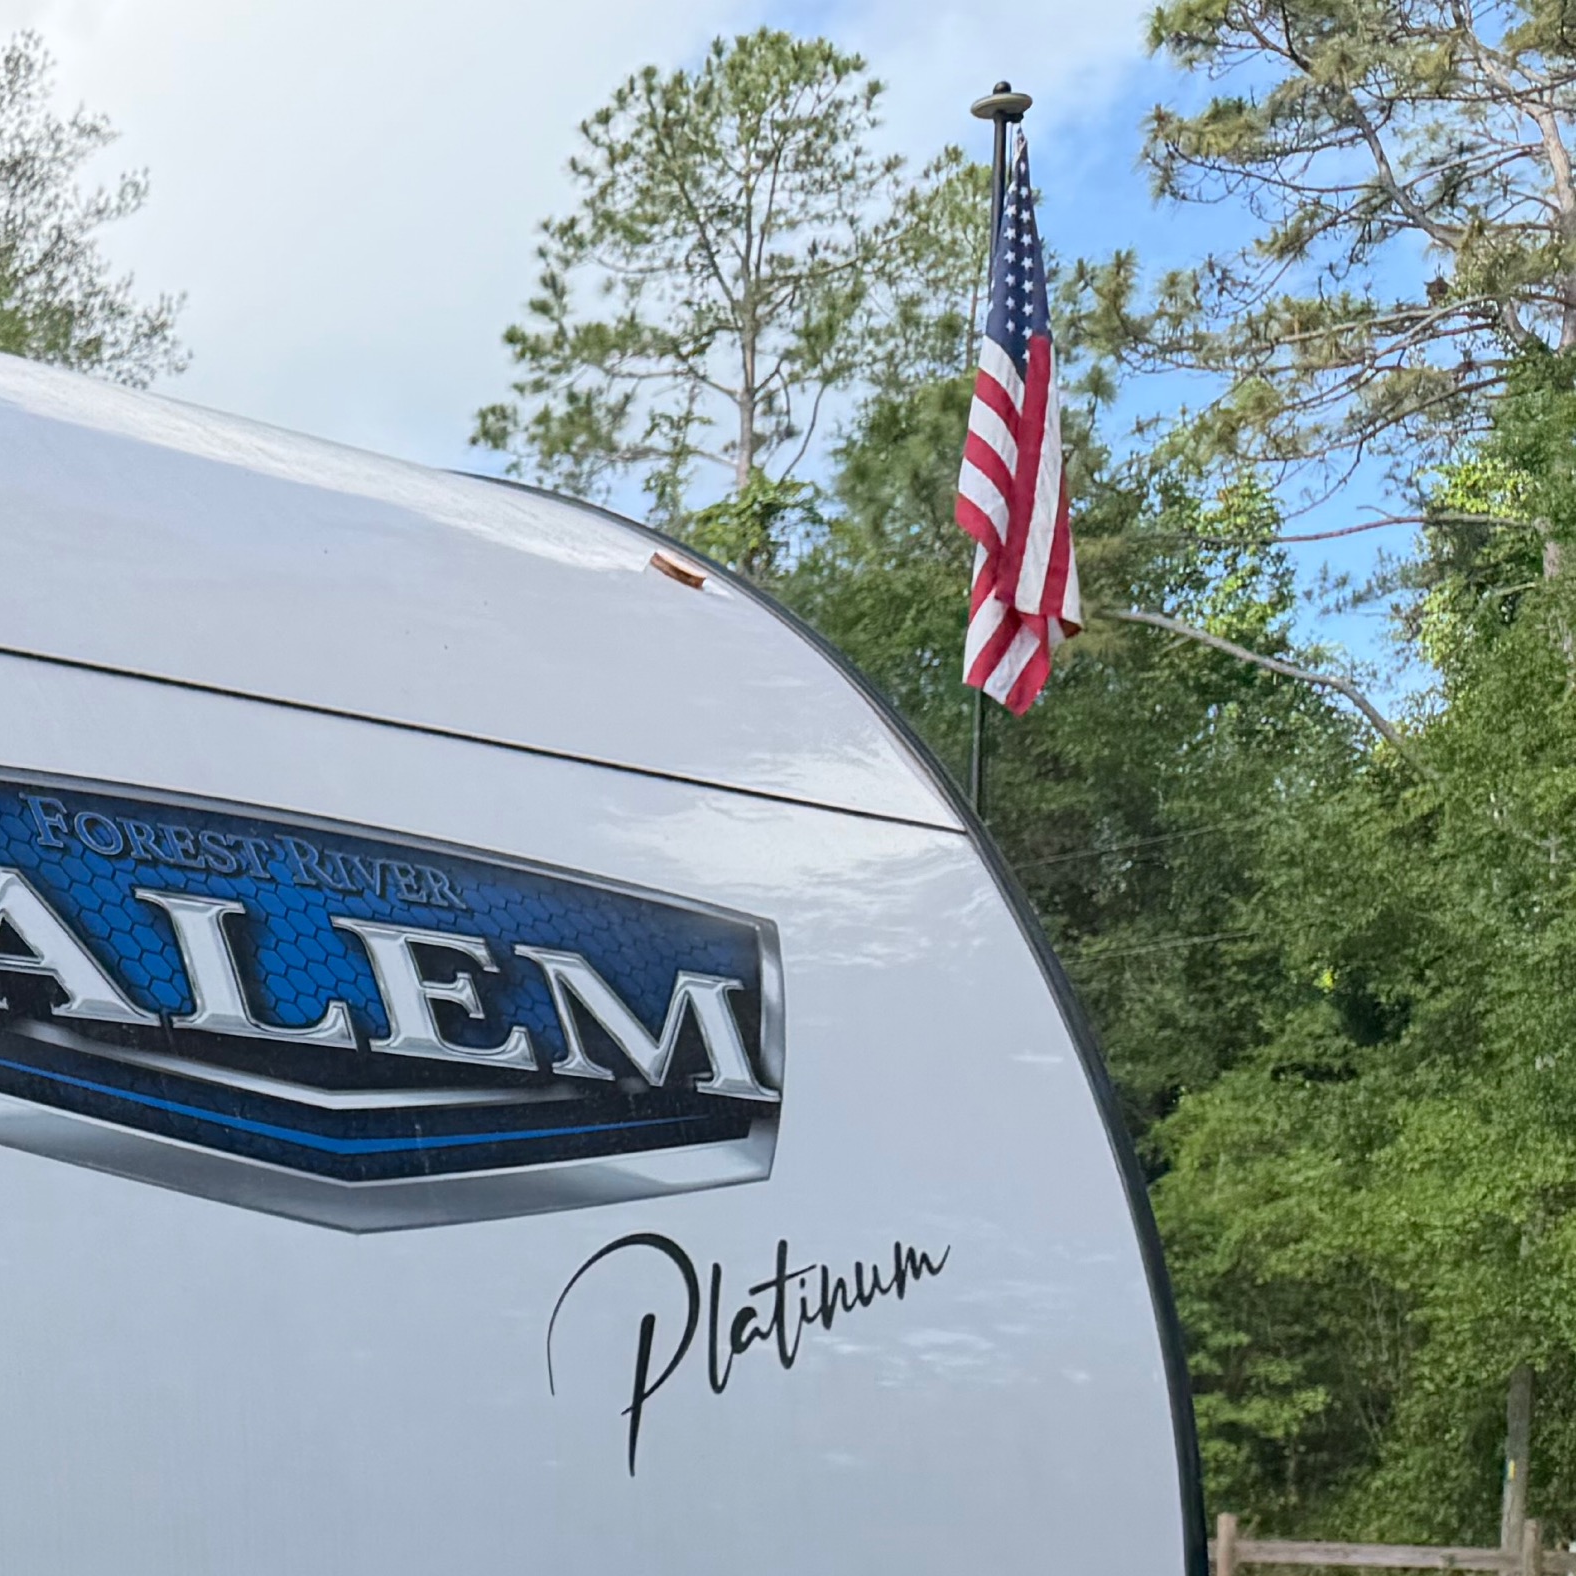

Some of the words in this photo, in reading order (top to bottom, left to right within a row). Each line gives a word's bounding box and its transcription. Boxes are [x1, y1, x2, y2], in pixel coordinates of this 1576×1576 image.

[18, 792, 272, 880] FOREST
[274, 833, 467, 909] RIVER
[546, 1232, 951, 1478] Platinum
